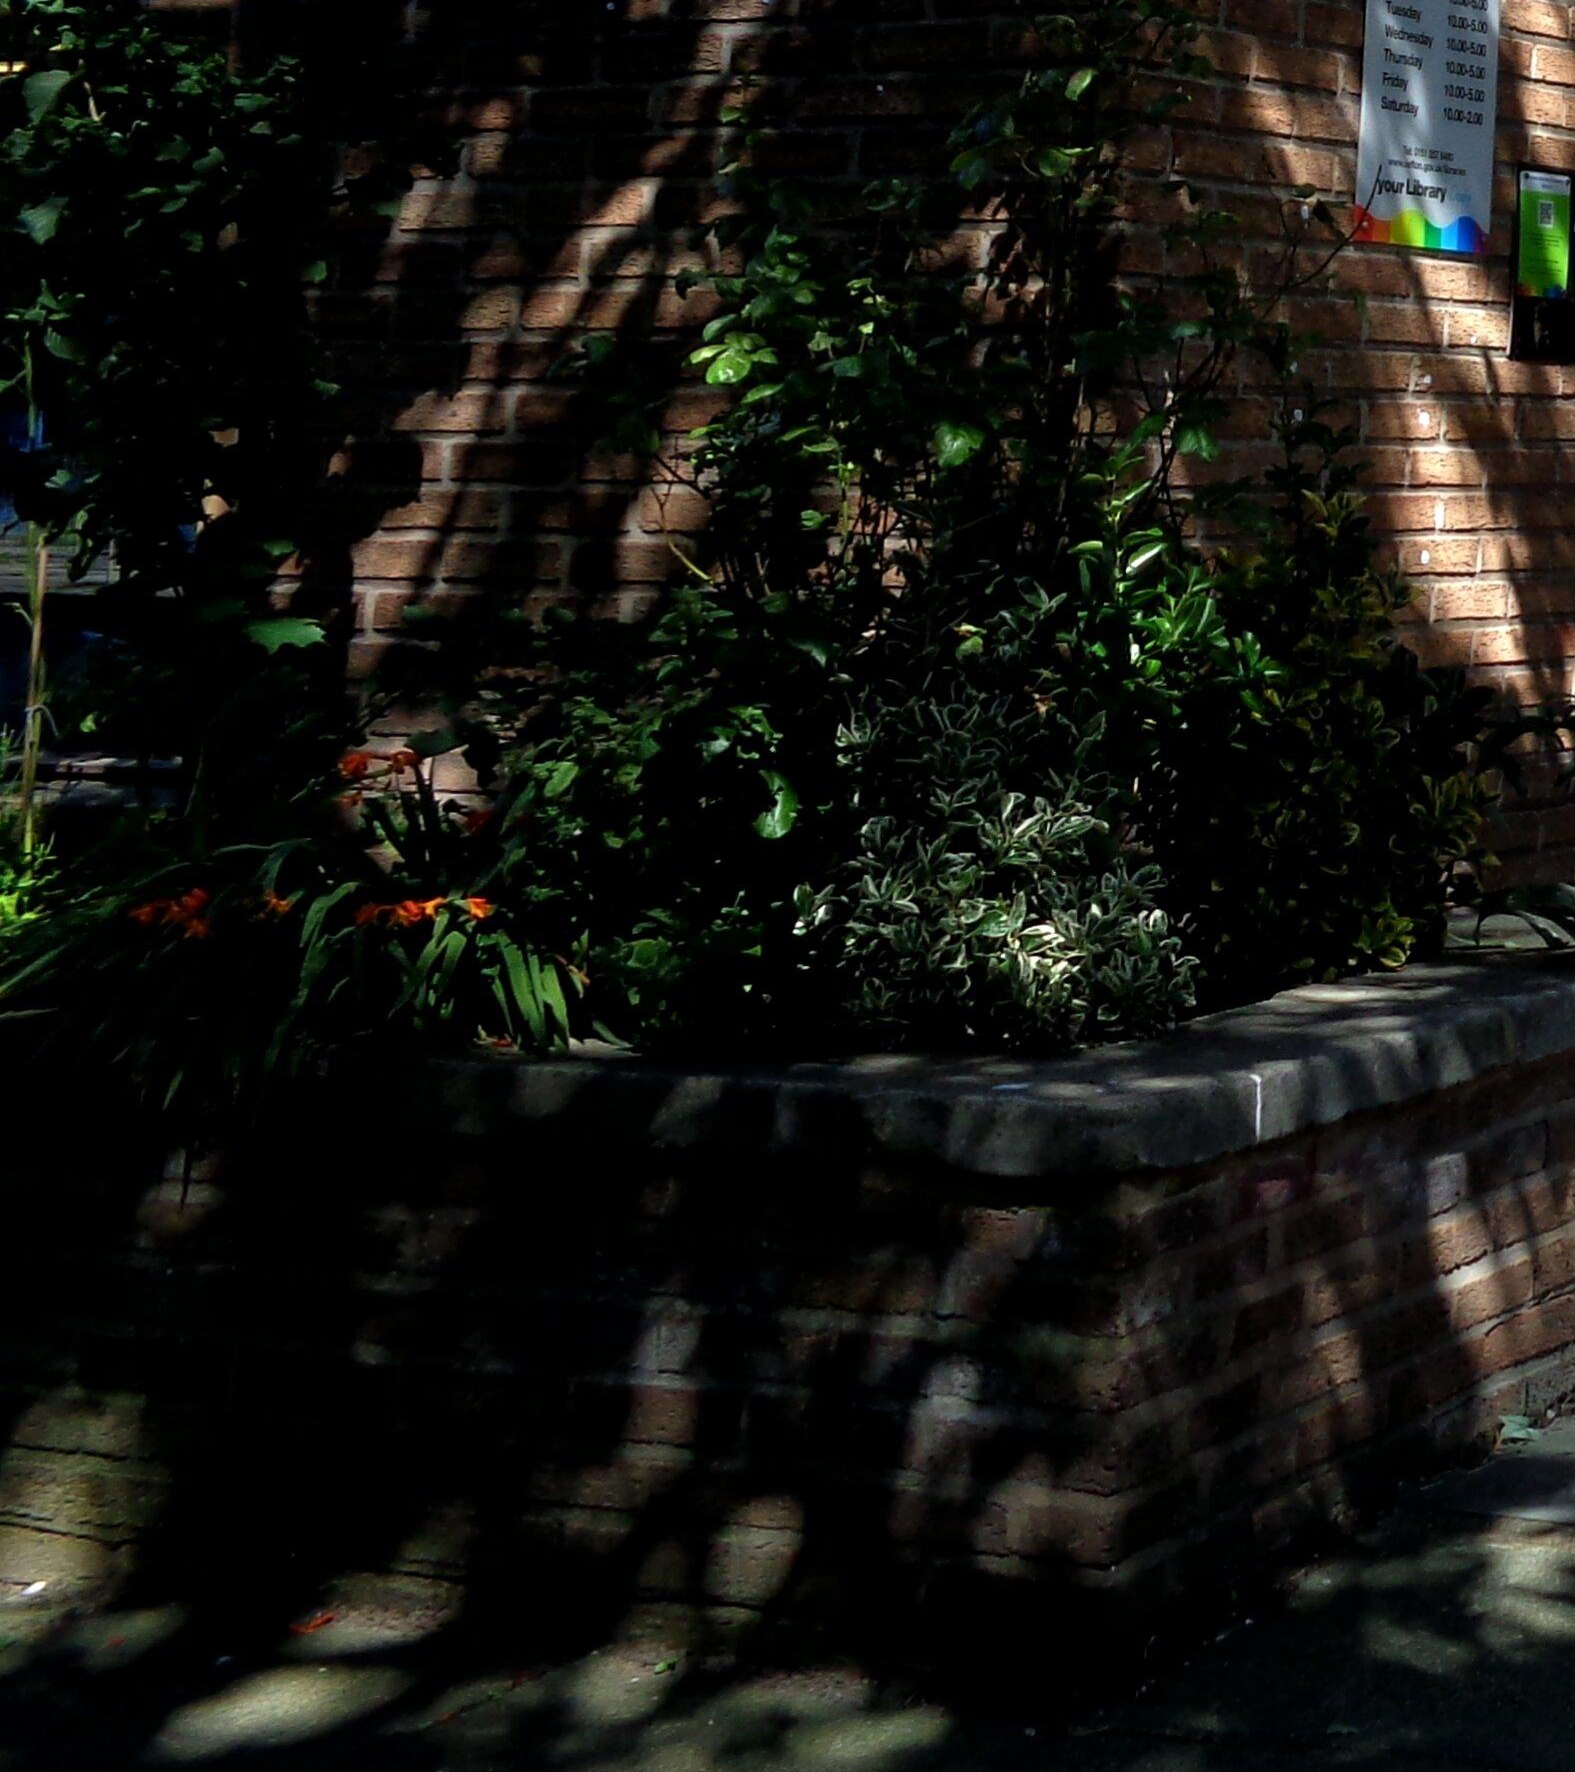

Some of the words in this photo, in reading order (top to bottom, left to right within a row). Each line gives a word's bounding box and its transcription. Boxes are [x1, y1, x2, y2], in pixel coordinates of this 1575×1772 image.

[1385, 0, 1422, 23] Tuesday
[1447, 15, 1488, 34] 10.00-5.00
[1385, 24, 1434, 49] Wednesday
[1446, 38, 1487, 57] 10.00-5.00
[1384, 48, 1423, 70] Thursday
[1446, 61, 1486, 80] 10.00-5.00
[1382, 72, 1409, 91] Friday
[1444, 84, 1485, 103] 10.00-5.00
[1381, 96, 1419, 117] Saturday
[1443, 108, 1484, 126] 10.00-2.00
[1377, 177, 1405, 196] your
[1406, 178, 1448, 203] Library
